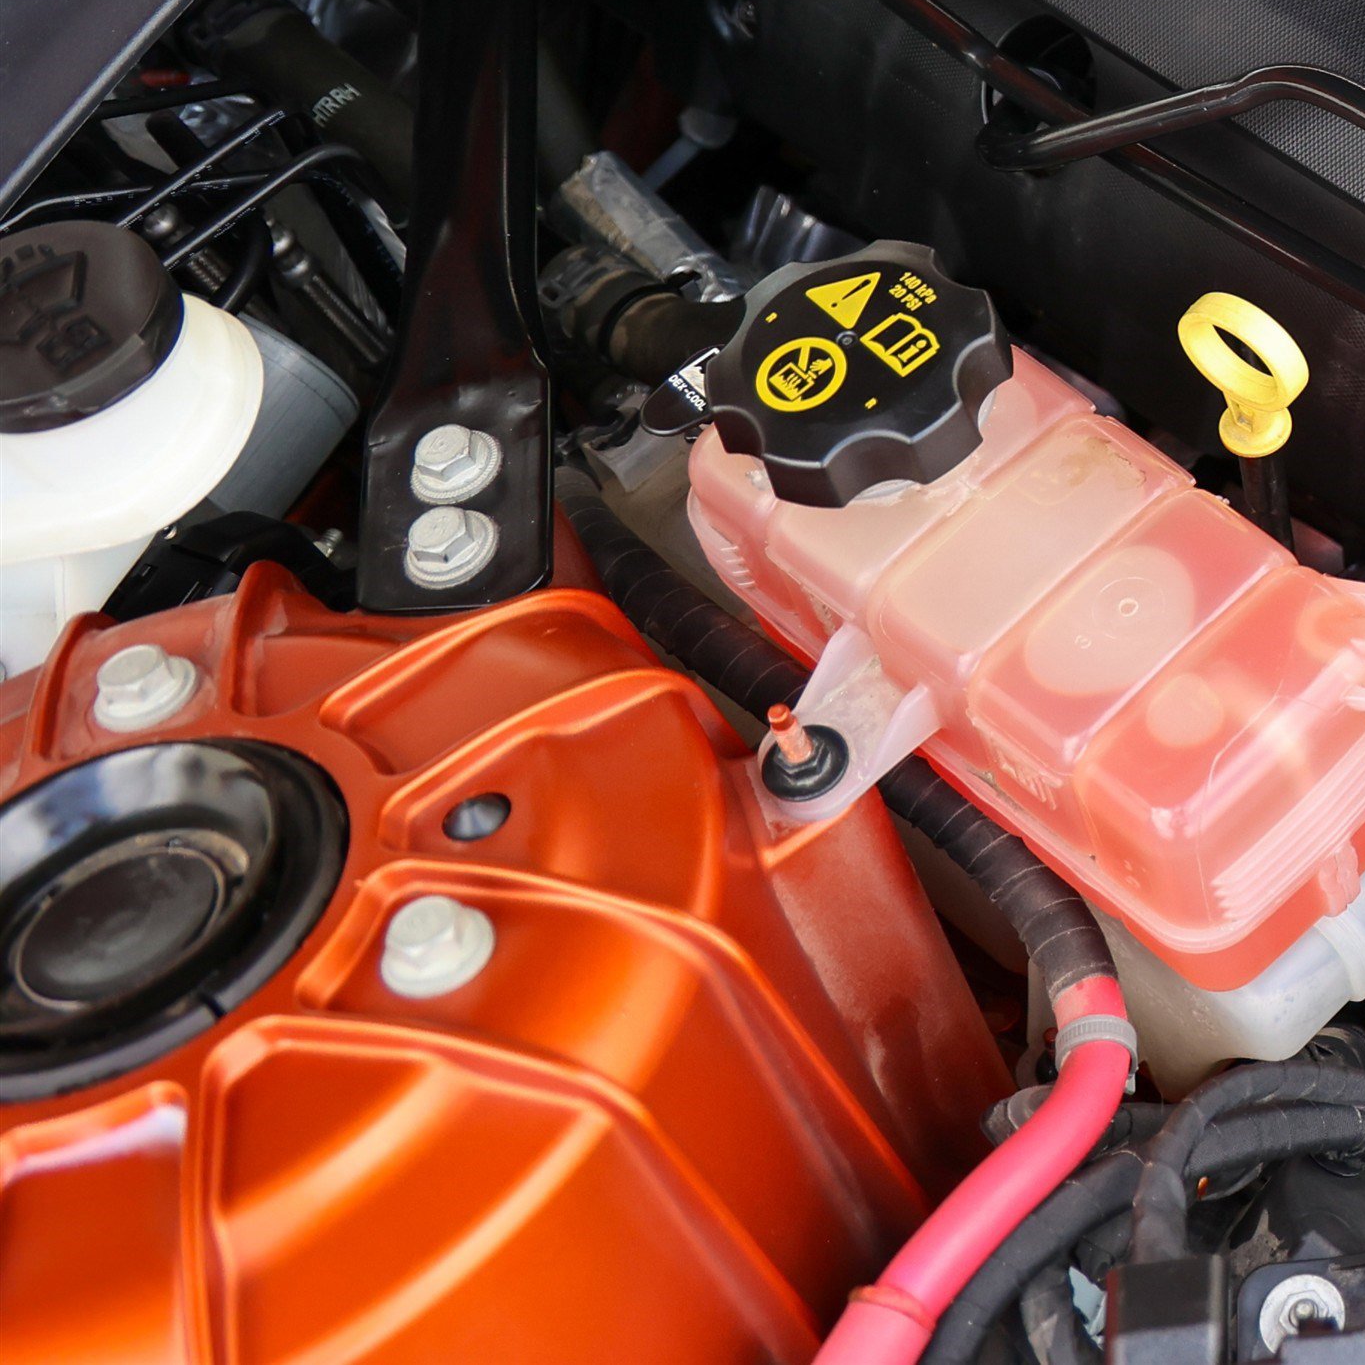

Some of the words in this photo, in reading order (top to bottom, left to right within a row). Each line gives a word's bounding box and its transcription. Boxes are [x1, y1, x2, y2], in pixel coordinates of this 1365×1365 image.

[888, 284, 908, 299] 20
[900, 293, 923, 312] PSI
[899, 271, 922, 290] 140
[914, 283, 937, 304] kPa
[667, 374, 707, 412] DEX-COOL
